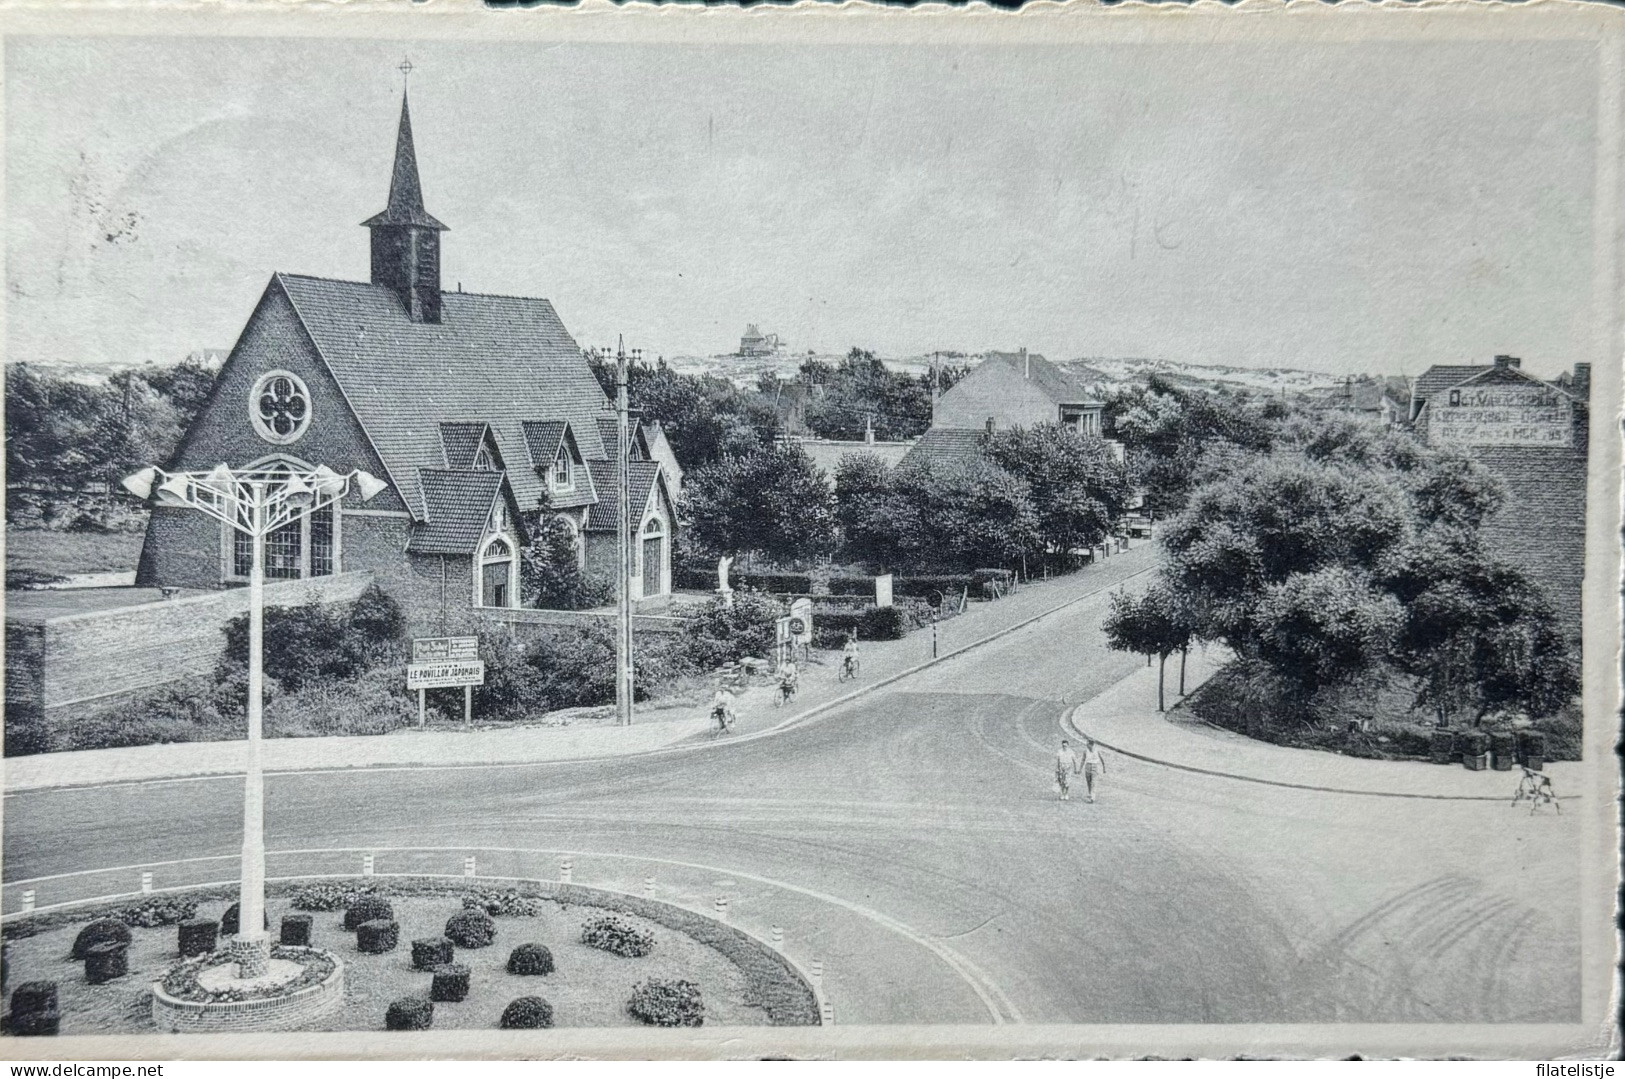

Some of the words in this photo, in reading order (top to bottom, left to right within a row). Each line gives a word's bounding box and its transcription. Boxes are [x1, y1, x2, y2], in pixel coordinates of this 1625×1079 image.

[410, 670, 418, 679] LE
[419, 668, 449, 679] PAVILLON
[450, 667, 480, 677] JAPONAIS
